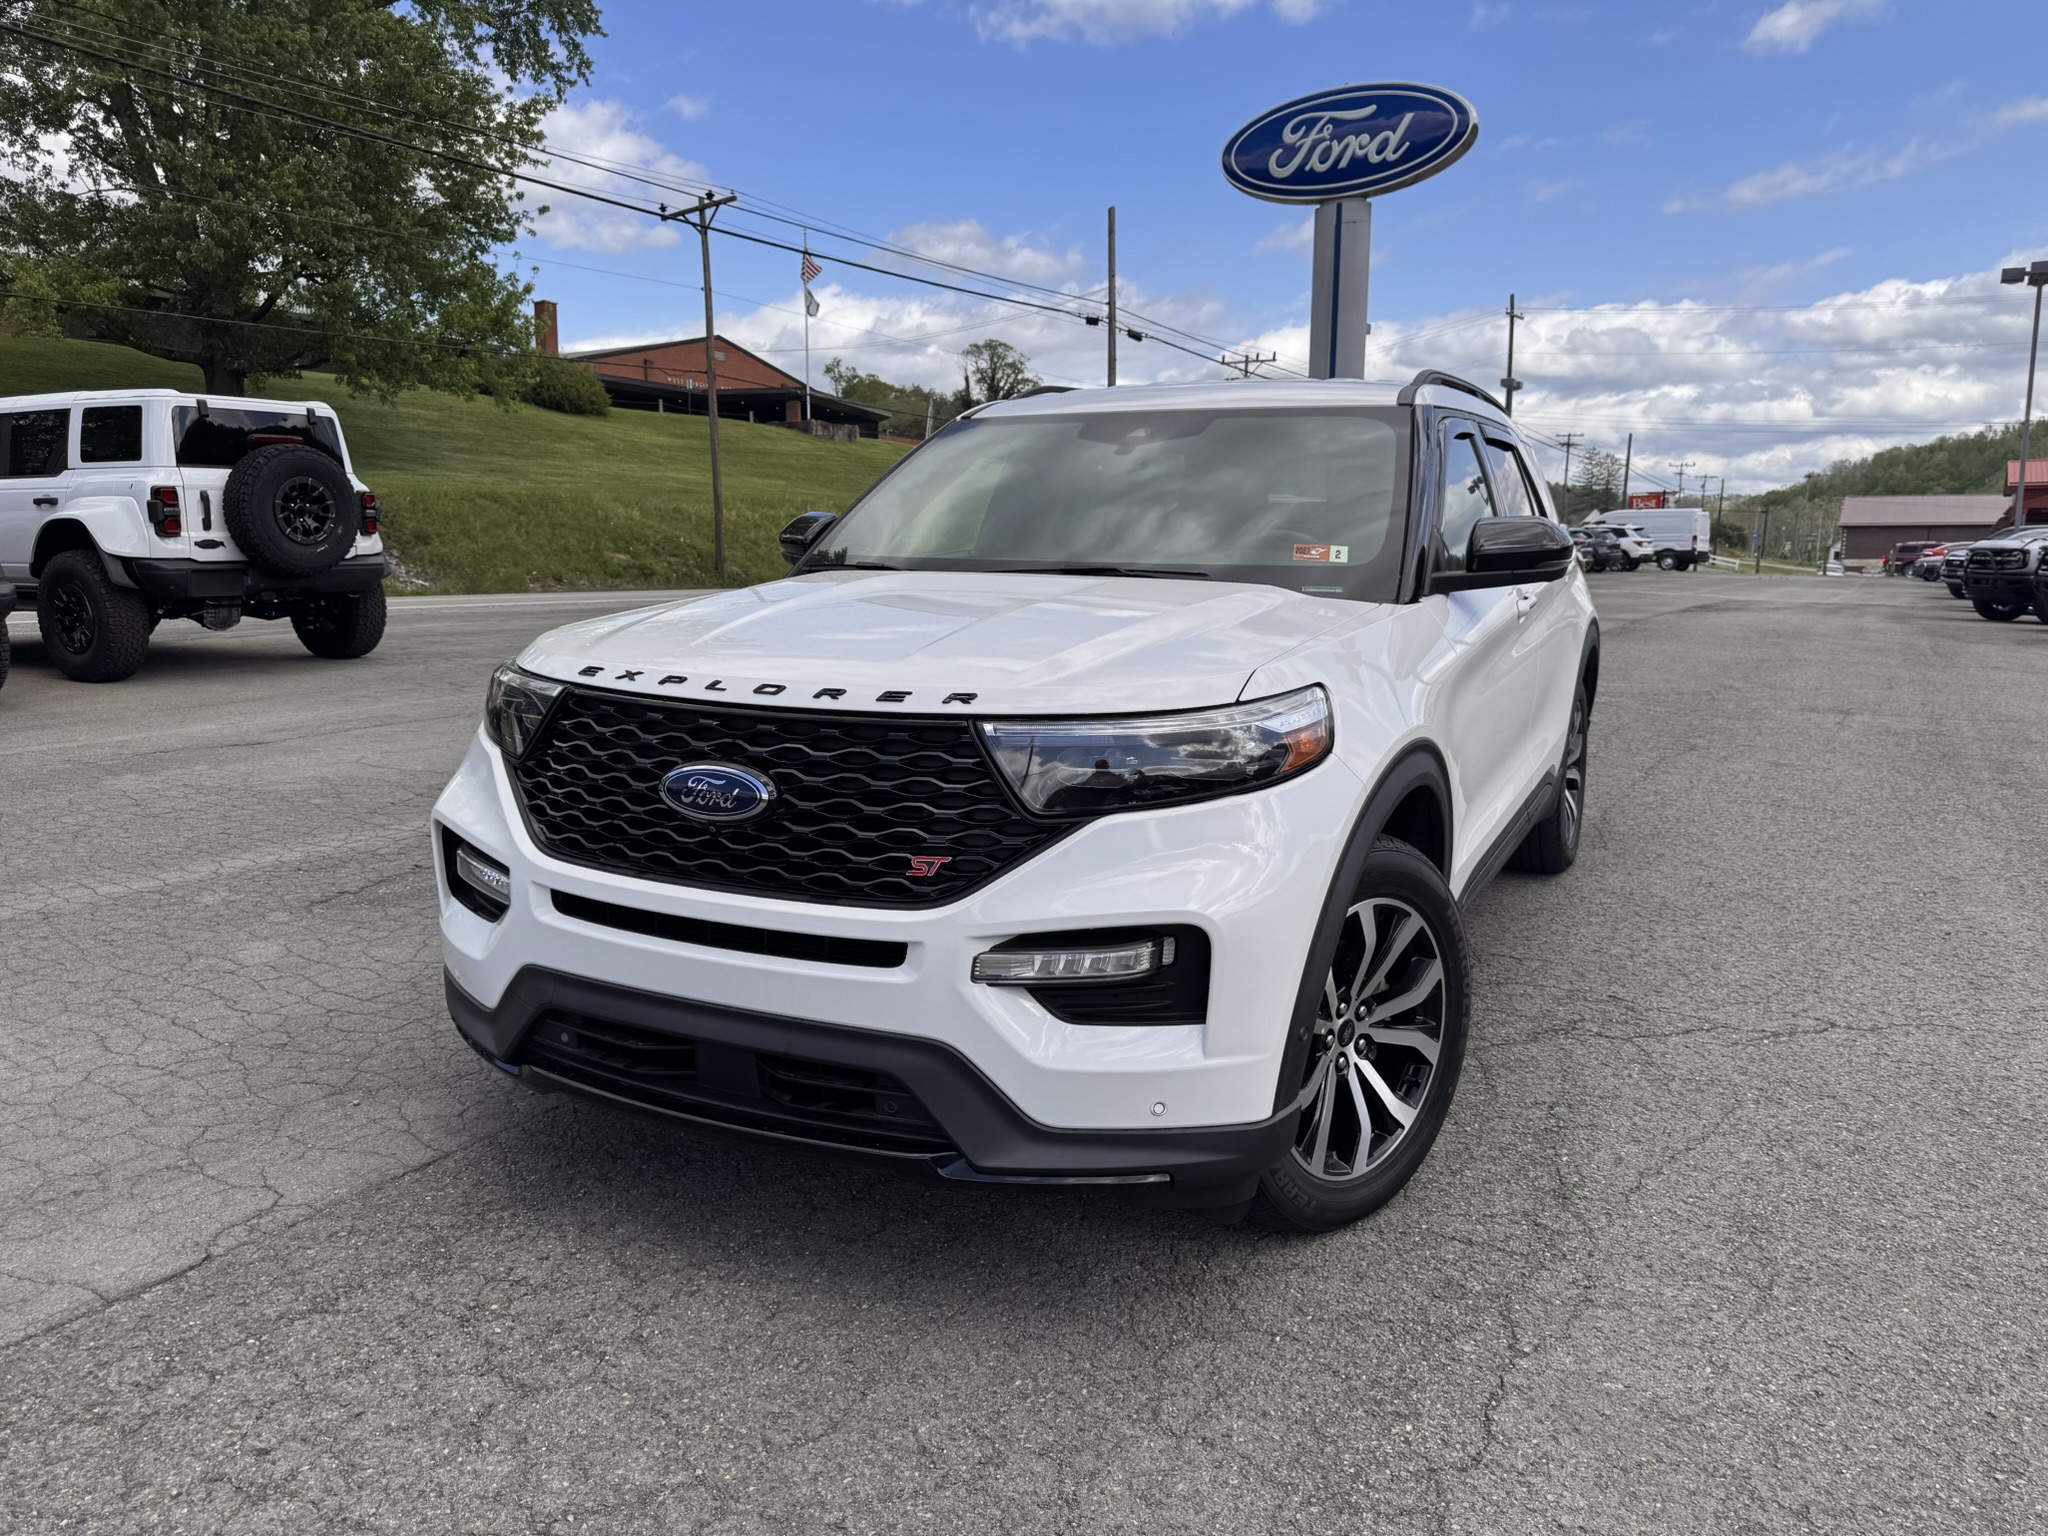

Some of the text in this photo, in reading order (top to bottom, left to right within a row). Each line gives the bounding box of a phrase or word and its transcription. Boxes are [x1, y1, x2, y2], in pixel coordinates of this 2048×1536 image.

[1268, 104, 1415, 179] Ford
[1335, 549, 1341, 559] 2
[577, 665, 979, 705] EXPLORER
[679, 775, 741, 810] Ford
[906, 856, 952, 877] ST
[1272, 1169, 1318, 1216] TERR
